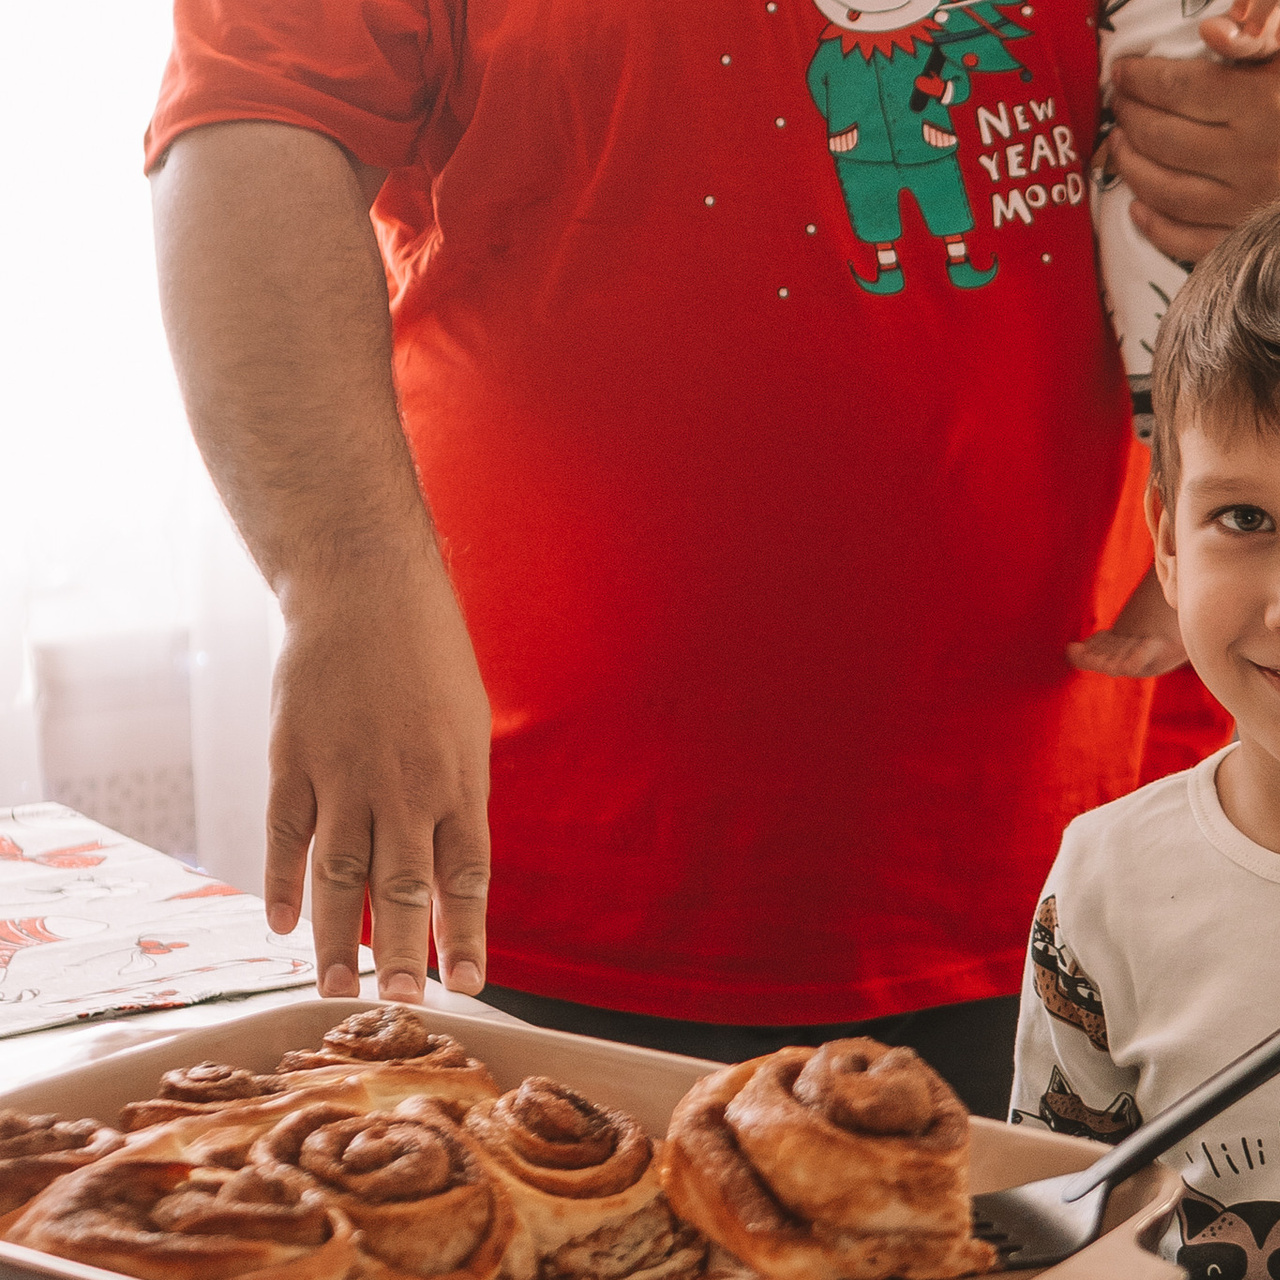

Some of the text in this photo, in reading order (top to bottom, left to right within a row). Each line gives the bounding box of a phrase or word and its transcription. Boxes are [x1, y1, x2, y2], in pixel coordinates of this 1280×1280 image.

[977, 98, 1055, 145] NEW
[978, 125, 1077, 182] YEAR
[991, 173, 1083, 228] MOOD
